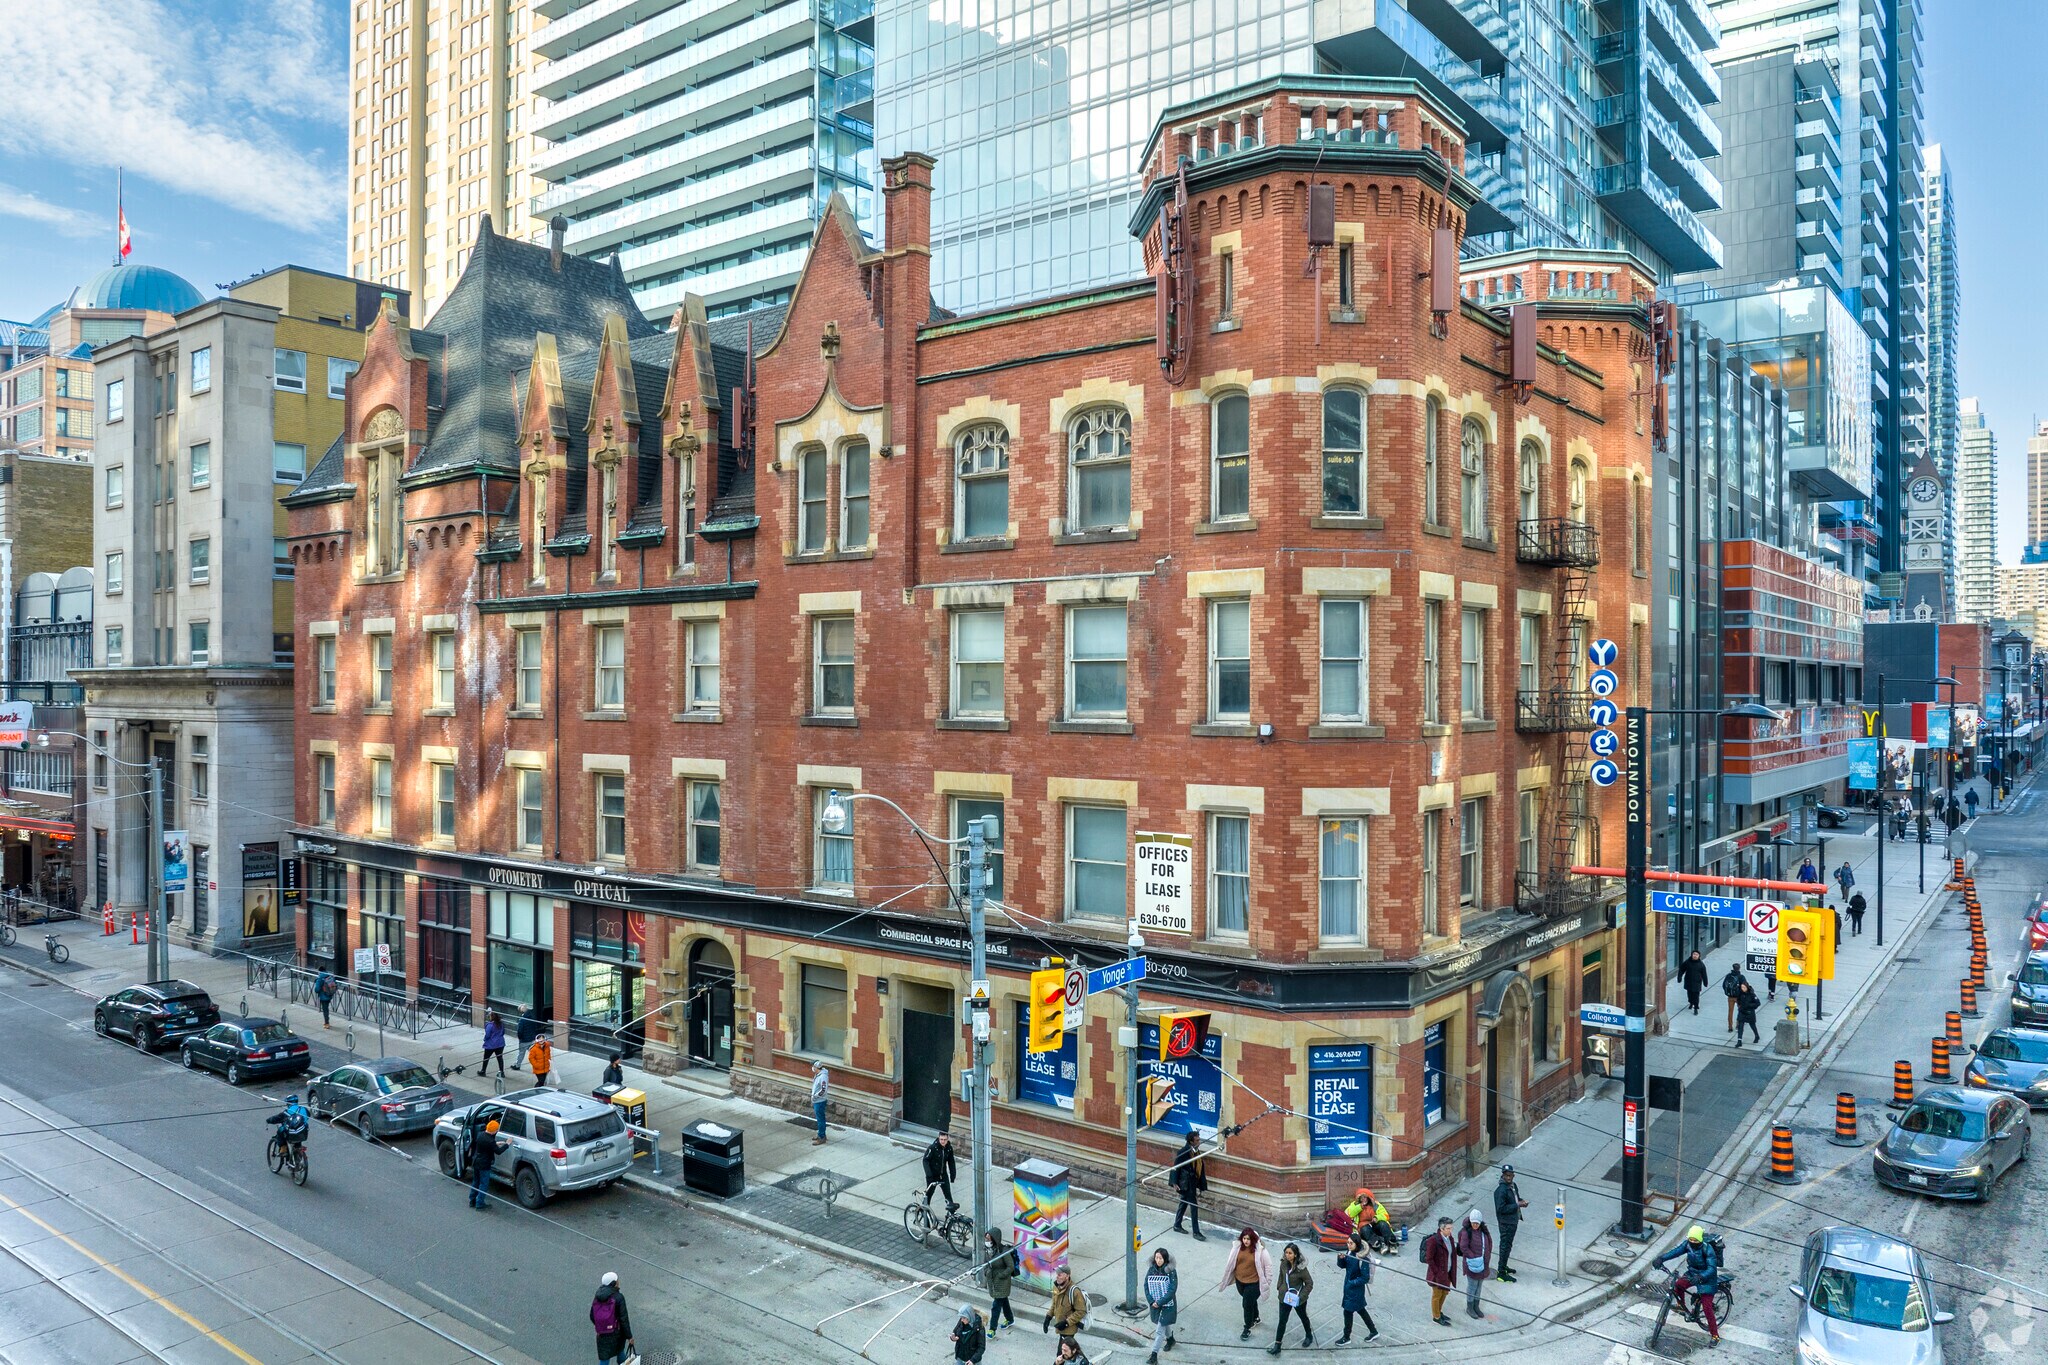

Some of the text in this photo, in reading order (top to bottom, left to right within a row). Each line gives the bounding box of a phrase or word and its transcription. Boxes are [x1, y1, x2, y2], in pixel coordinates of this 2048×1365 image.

[1222, 458, 1246, 468] suite 304
[1343, 455, 1354, 463] 304
[0, 712, 22, 722] an's
[1590, 639, 1617, 786] Yonge
[1628, 718, 1639, 822] DOWNTOWN
[1139, 846, 1188, 862] OFFICES
[1151, 863, 1174, 877] FOR
[489, 867, 543, 889] OPTOMETRY
[574, 879, 631, 903] OPTICAL
[1145, 882, 1181, 898] LEASE
[1155, 904, 1170, 913] 416
[1665, 894, 1731, 914] College St
[1140, 914, 1186, 929] 630-6700
[1526, 933, 1544, 948] OFFICE
[1544, 927, 1559, 941] SPACE
[1567, 918, 1581, 933] LEASE
[880, 928, 1008, 955] COMMERCIAL SPACE FO EASE
[1754, 956, 1775, 964] BUSES
[1749, 963, 1776, 972] EXCEPTE
[1102, 968, 1125, 985] Yonge
[1587, 1012, 1612, 1023] College
[1025, 1049, 1046, 1063] FOR
[1025, 1060, 1055, 1076] LEASE
[1150, 1059, 1193, 1079] RETAIL
[1314, 1078, 1359, 1091] RETAIL
[1314, 1091, 1342, 1103] FOR
[1314, 1103, 1355, 1115] LEASE
[1334, 1170, 1358, 1182] 450
